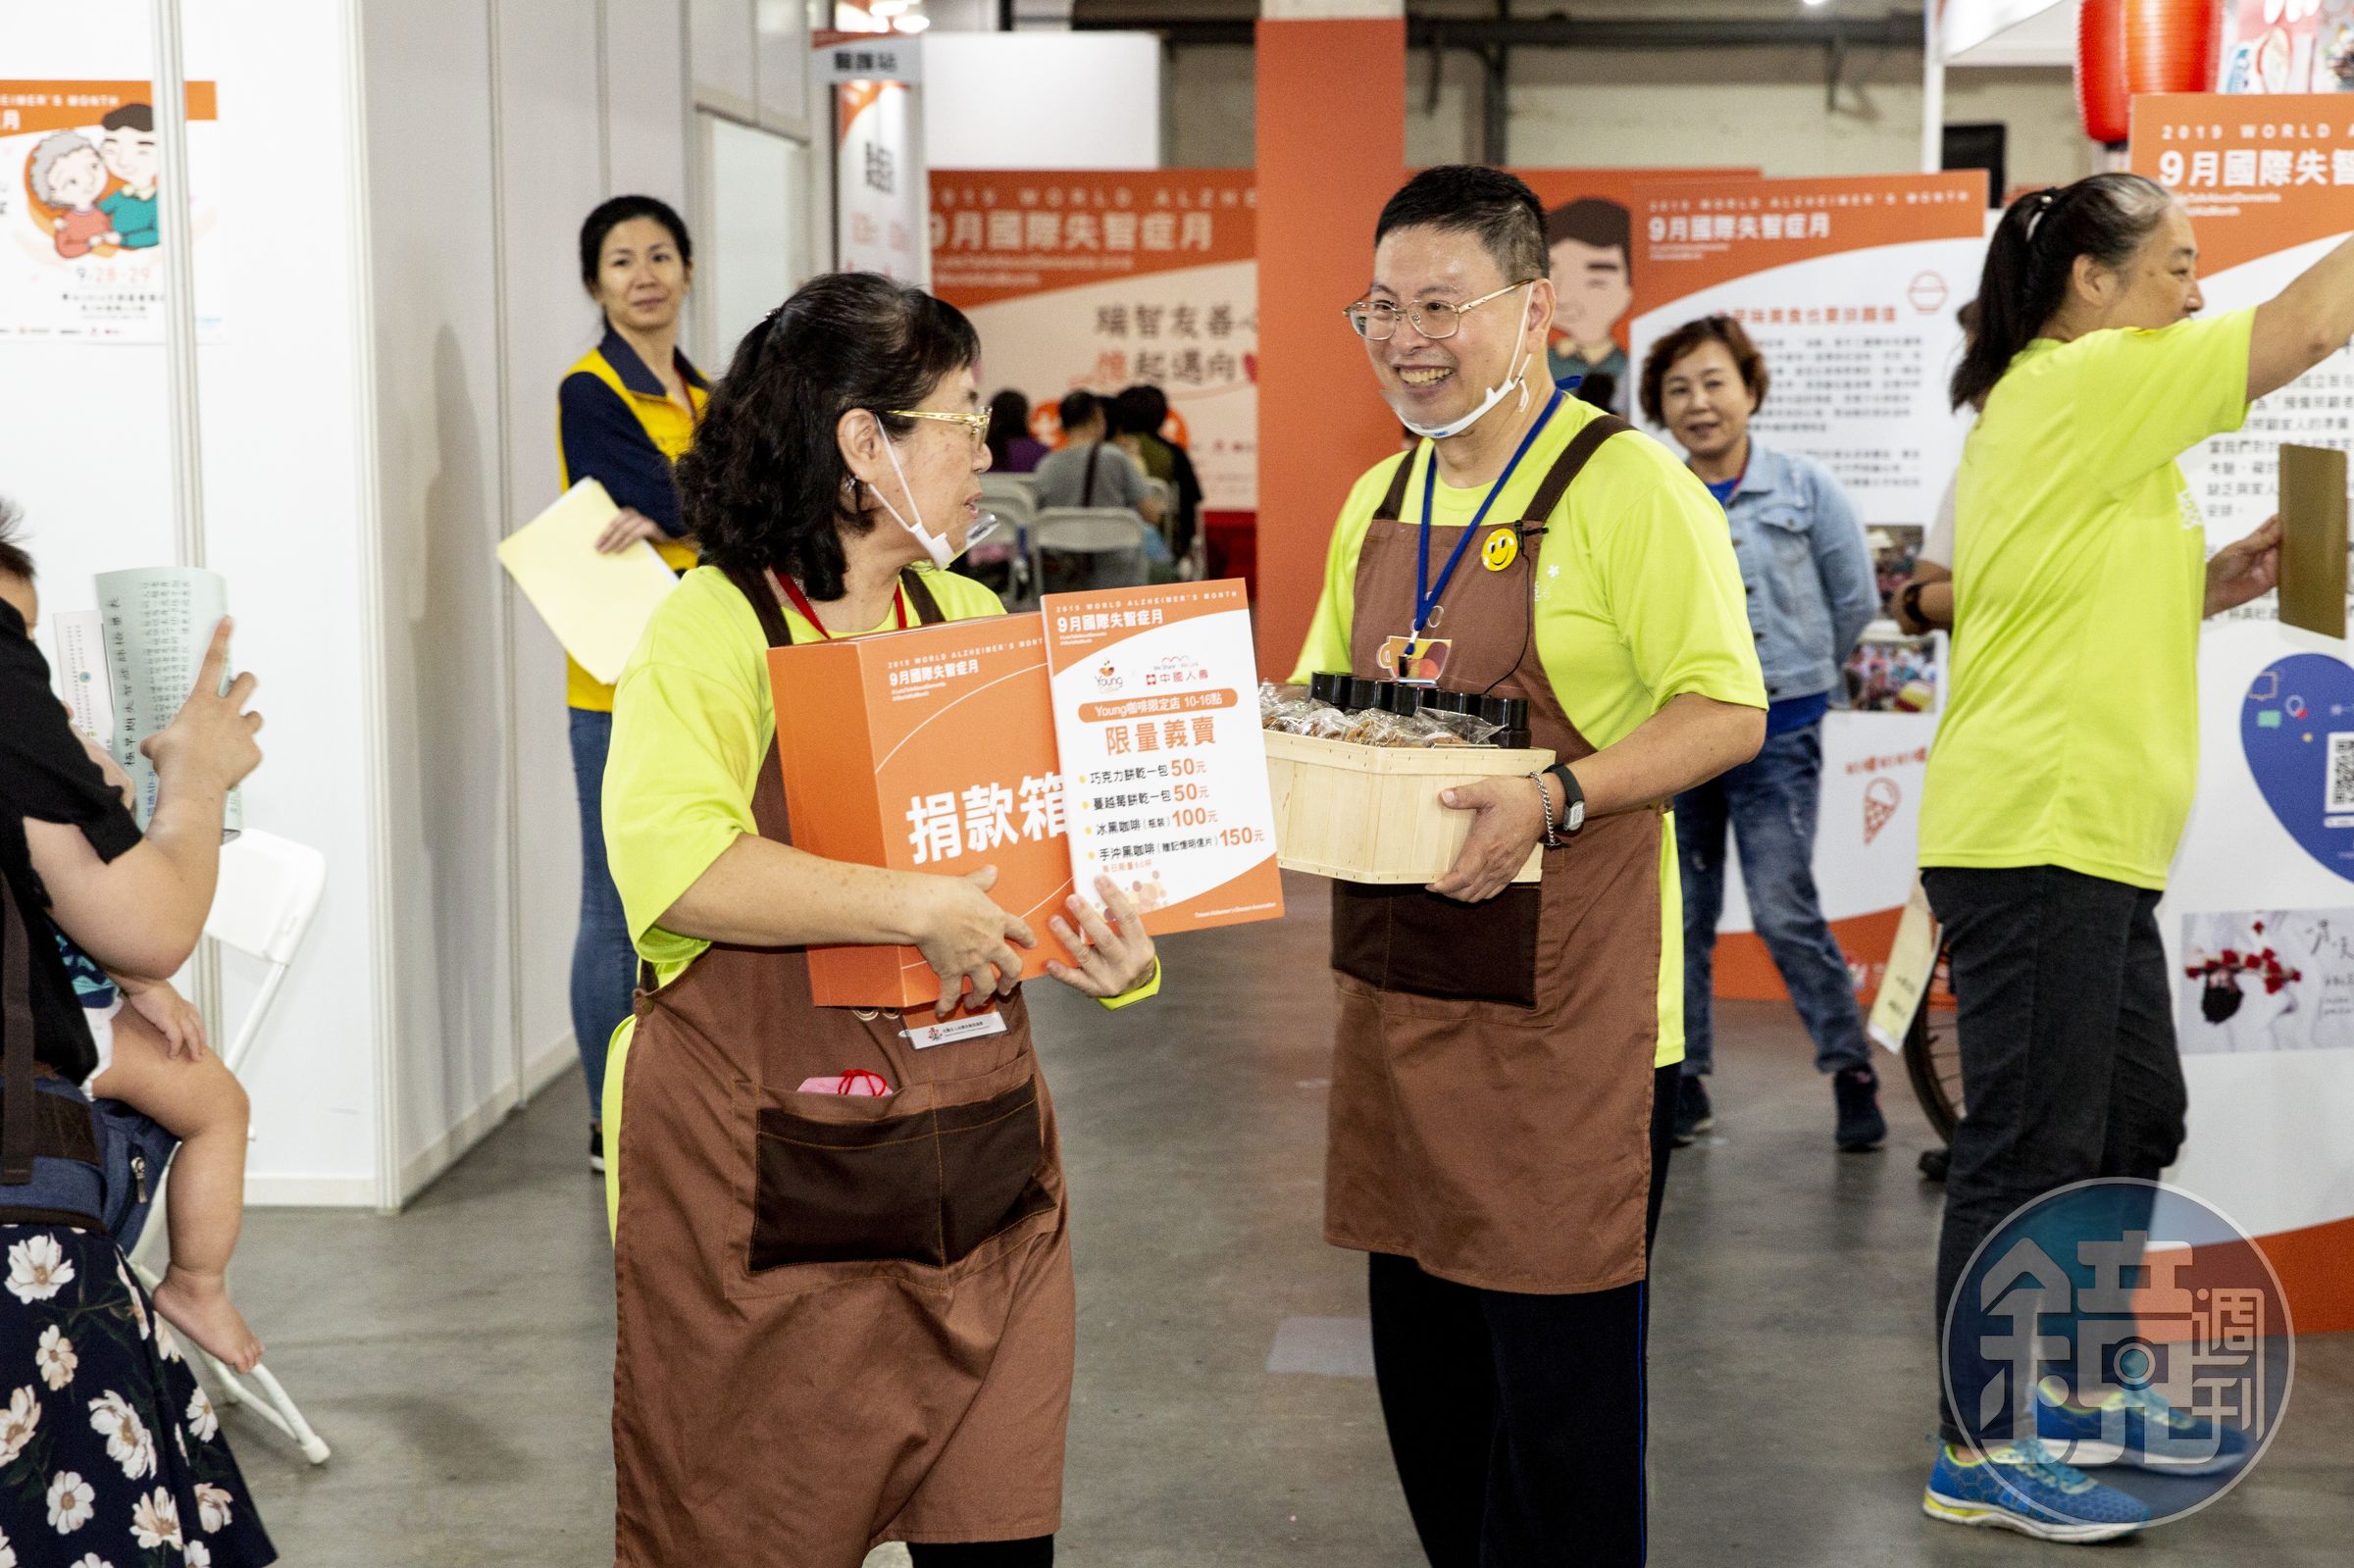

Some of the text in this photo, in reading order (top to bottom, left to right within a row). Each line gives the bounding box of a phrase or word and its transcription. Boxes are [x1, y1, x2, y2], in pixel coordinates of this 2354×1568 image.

[2161, 125, 2224, 140] 2019
[2239, 124, 2330, 139] WORLD
[1019, 186, 1133, 208] WORLD
[1700, 198, 1761, 210] WORLD
[1906, 190, 1970, 203] MONTH
[1649, 212, 1830, 242] 9月國際失智症月
[1056, 590, 1238, 613] 2019 WORLD ALZHEIMER'S MONTH
[1056, 609, 1163, 632] 9月國際失智症月
[888, 660, 910, 670] 2019
[914, 653, 947, 665] WORLD
[951, 643, 1015, 659] ALZHEIMER'S
[889, 659, 979, 686] 9月國際失智症月
[1095, 676, 1123, 688] Young
[1160, 670, 1208, 683] 中國人壽
[1095, 691, 1223, 718] Young咖啡限定店 10-16點
[1105, 716, 1216, 756] 限量義賣
[905, 771, 1069, 865] 捐款箱
